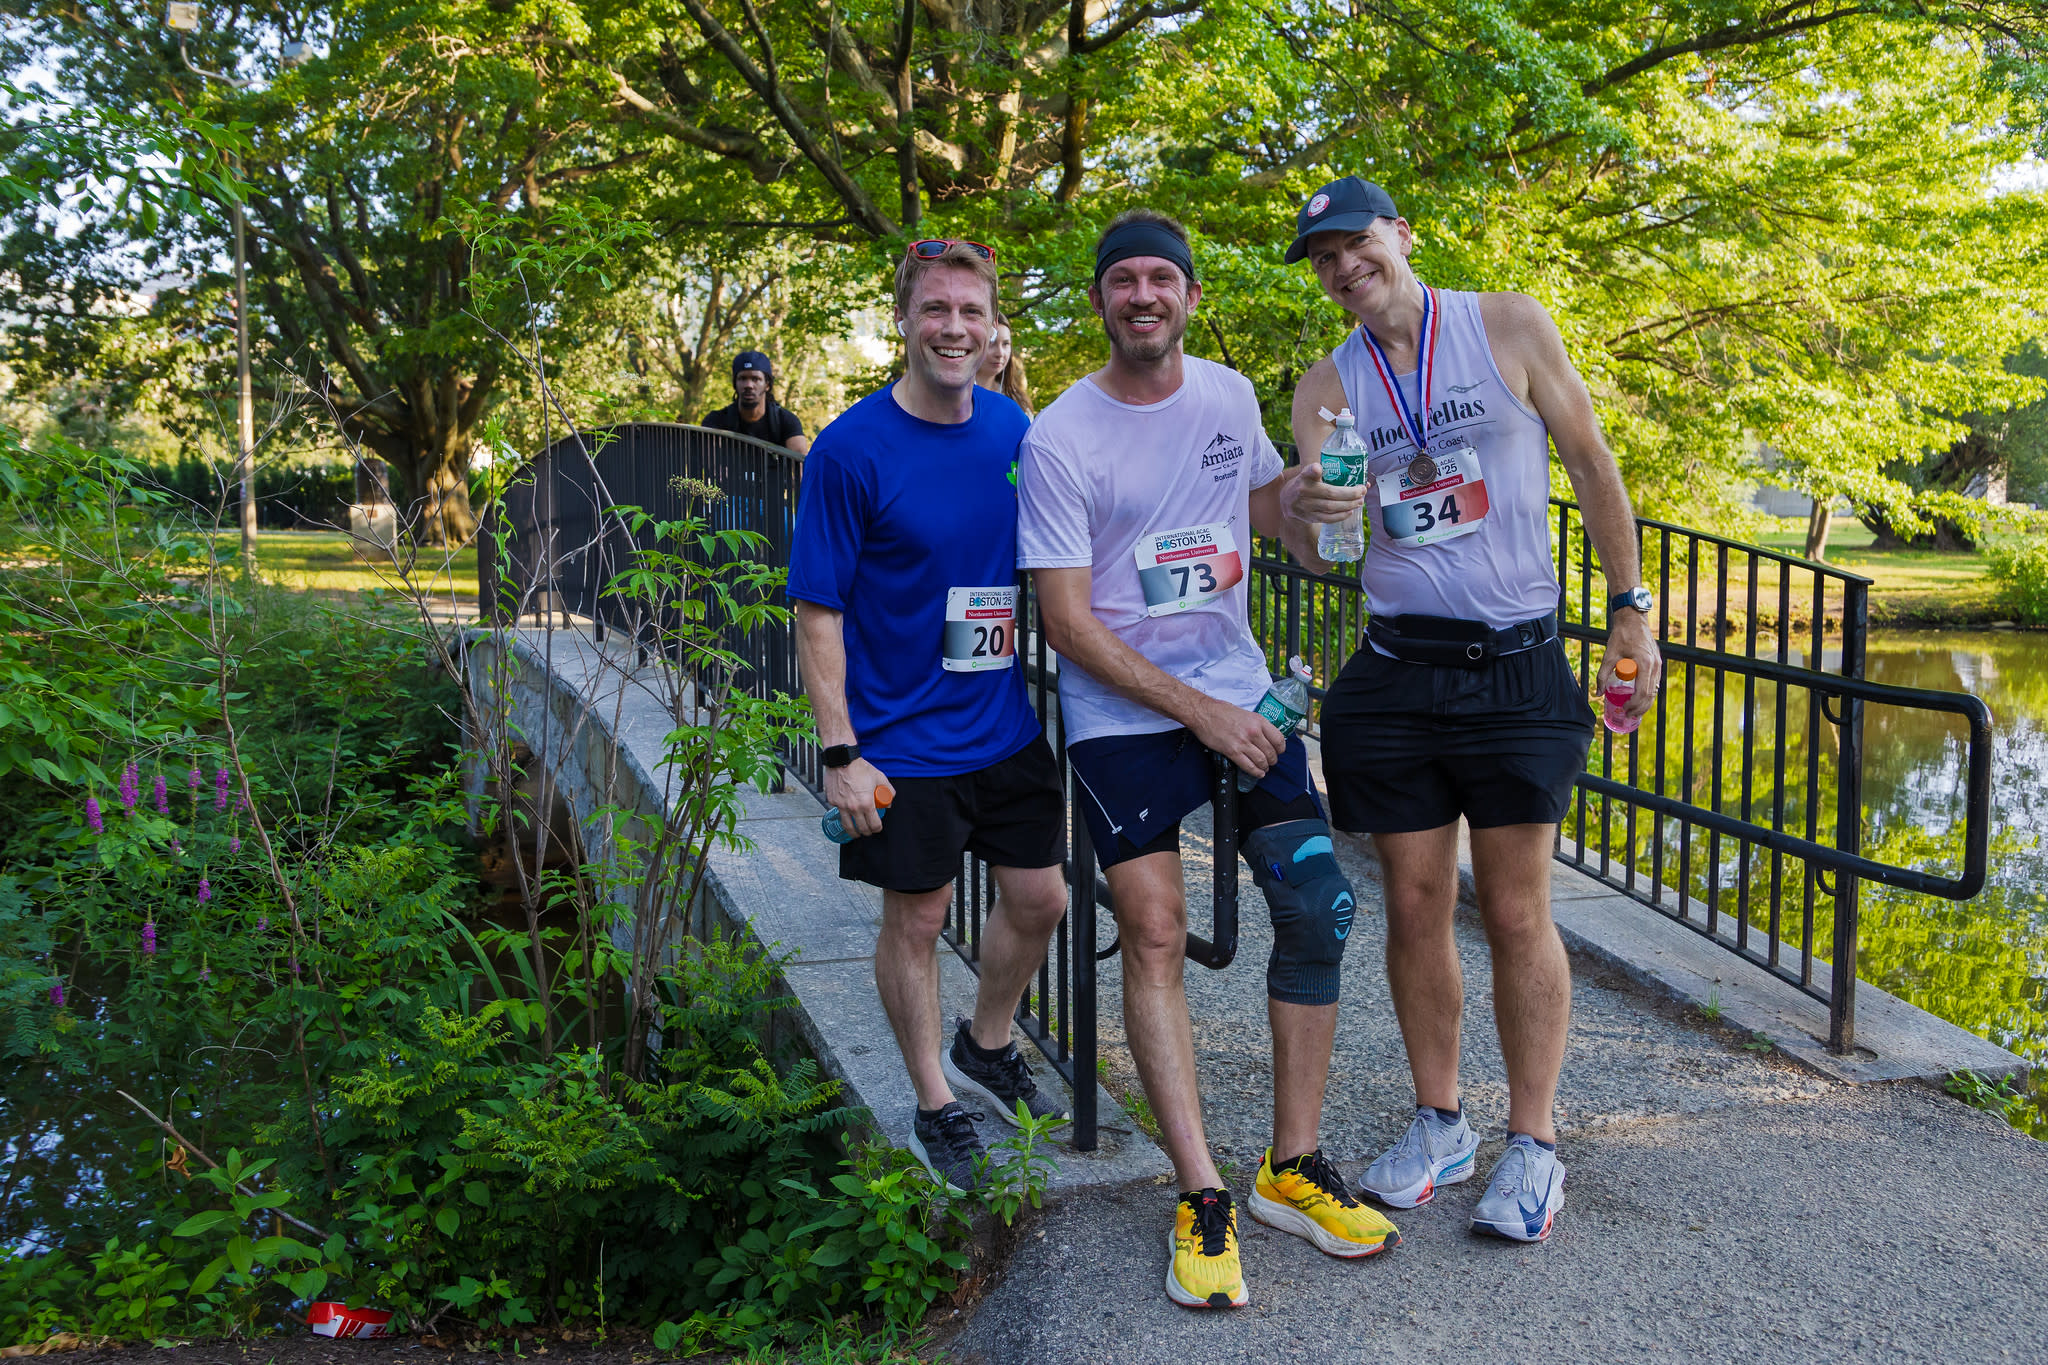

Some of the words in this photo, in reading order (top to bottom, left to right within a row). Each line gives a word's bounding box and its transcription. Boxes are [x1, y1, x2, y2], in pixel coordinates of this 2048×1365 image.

[1201, 445, 1244, 470] Amiata
[1397, 449, 1420, 465] Hoo
[1426, 445, 1436, 455] to
[1438, 434, 1465, 450] Coast
[1442, 462, 1458, 475] '25
[1435, 478, 1460, 489] University
[1413, 494, 1461, 532] 34
[1154, 530, 1196, 542] INTERNATIONAL
[1155, 536, 1198, 551] BOSTON
[1197, 533, 1213, 544] '25
[1159, 551, 1190, 561] Northeastern
[1190, 547, 1215, 556] University
[1170, 563, 1217, 597] 73
[969, 596, 1002, 607] BOSTON
[1003, 596, 1013, 606] '25
[972, 625, 1004, 657] 20
